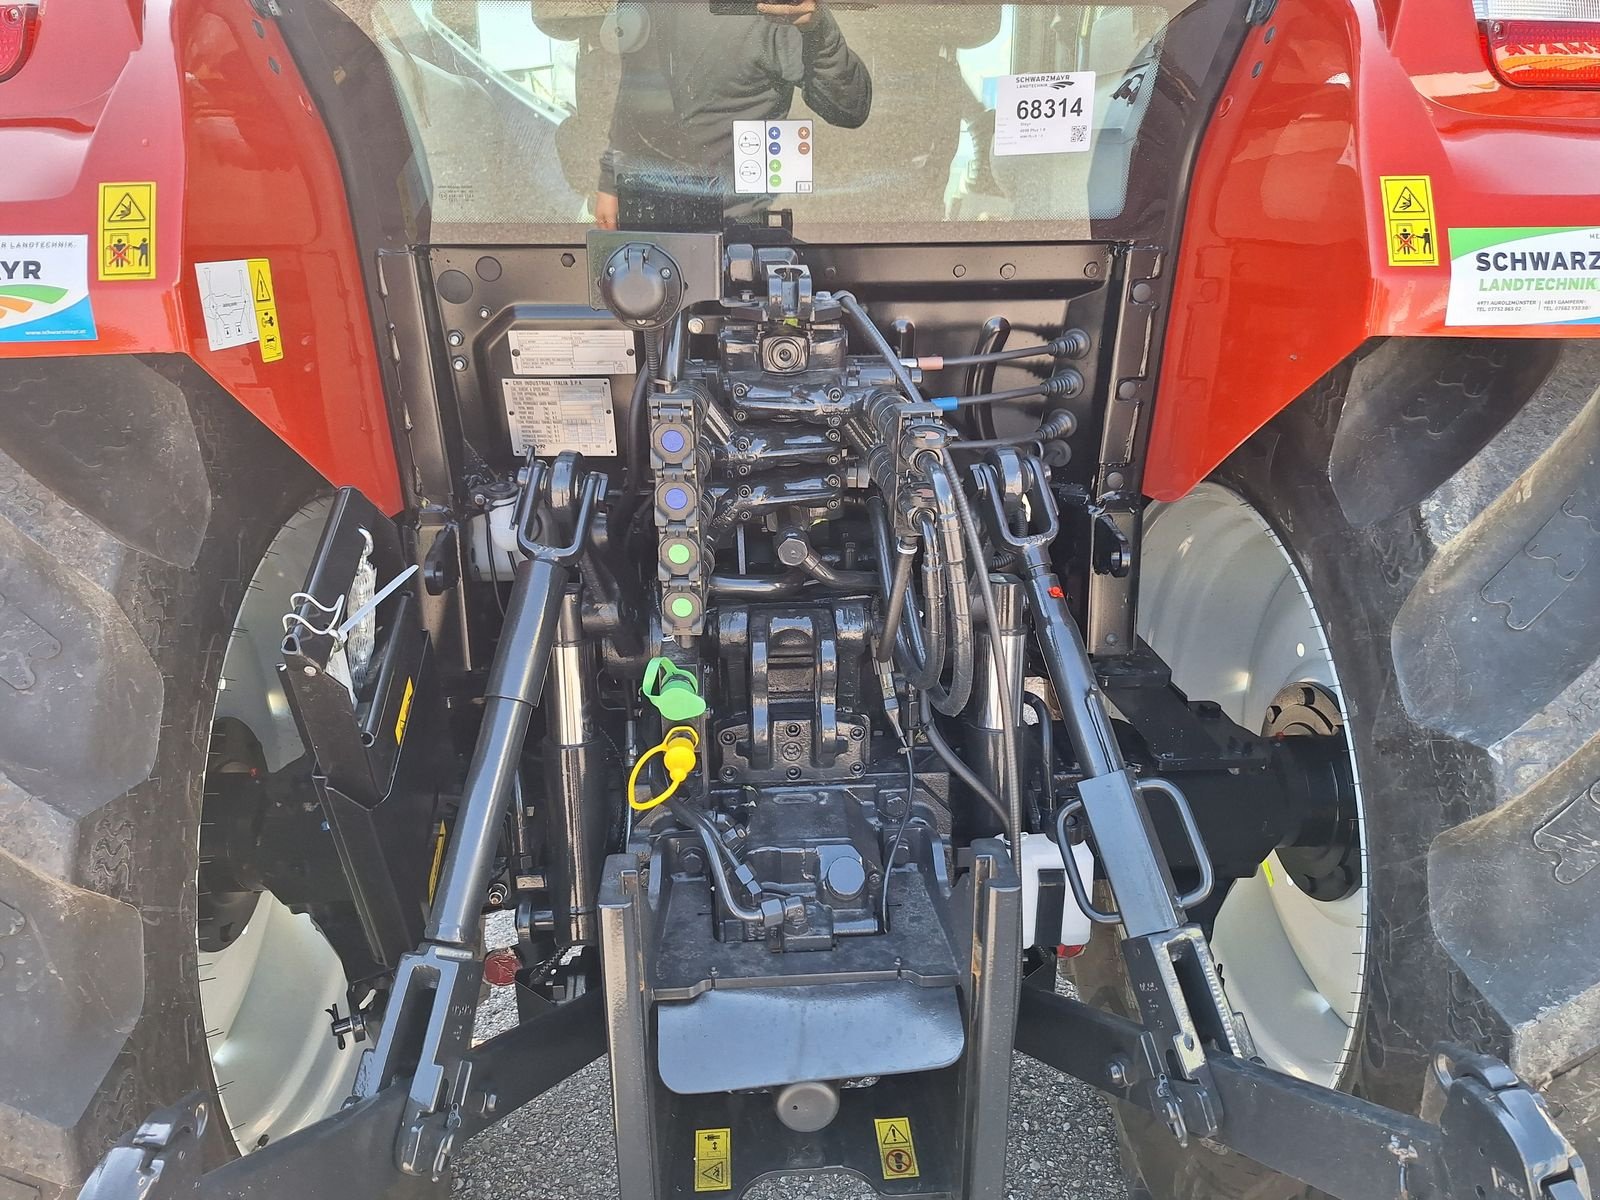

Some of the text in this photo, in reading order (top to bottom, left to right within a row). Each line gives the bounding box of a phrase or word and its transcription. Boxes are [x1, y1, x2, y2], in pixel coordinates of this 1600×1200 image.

[1015, 75, 1070, 83] SCHWARZMAYR
[1016, 97, 1083, 119] 68314
[0, 261, 42, 280] YR
[1475, 251, 1600, 272] SCHWARZ
[1479, 278, 1597, 291] LANDTECHNIK
